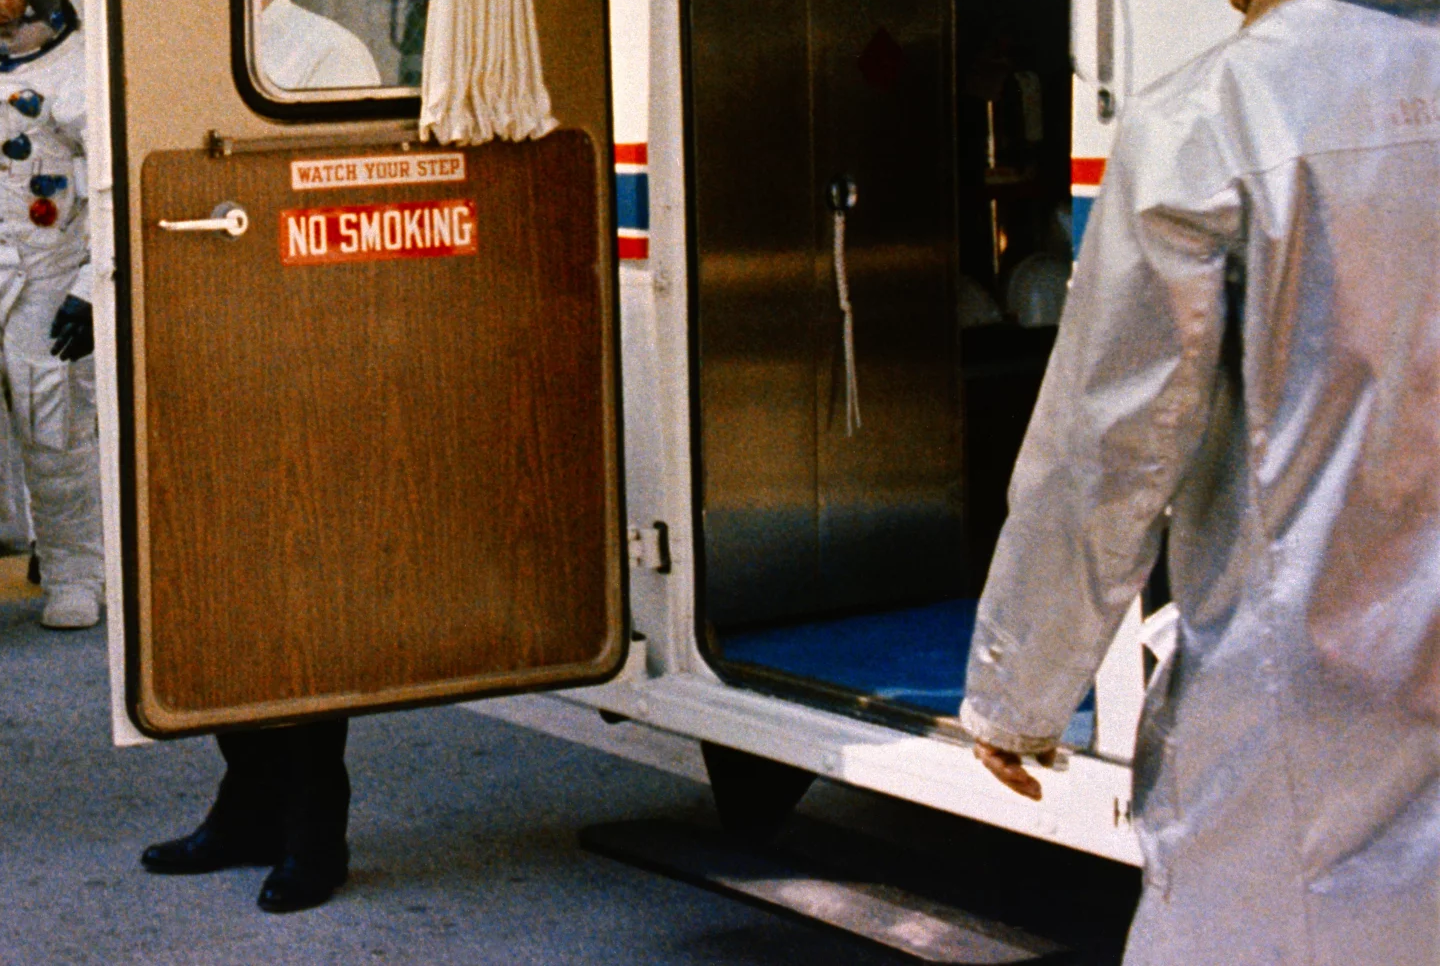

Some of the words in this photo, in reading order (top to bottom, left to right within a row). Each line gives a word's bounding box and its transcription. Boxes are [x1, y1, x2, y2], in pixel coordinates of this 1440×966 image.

[297, 164, 357, 183] WATCH
[364, 161, 410, 180] YOUR
[417, 158, 460, 176] STEP
[288, 215, 327, 257] NO
[339, 206, 473, 254] SMOKING
